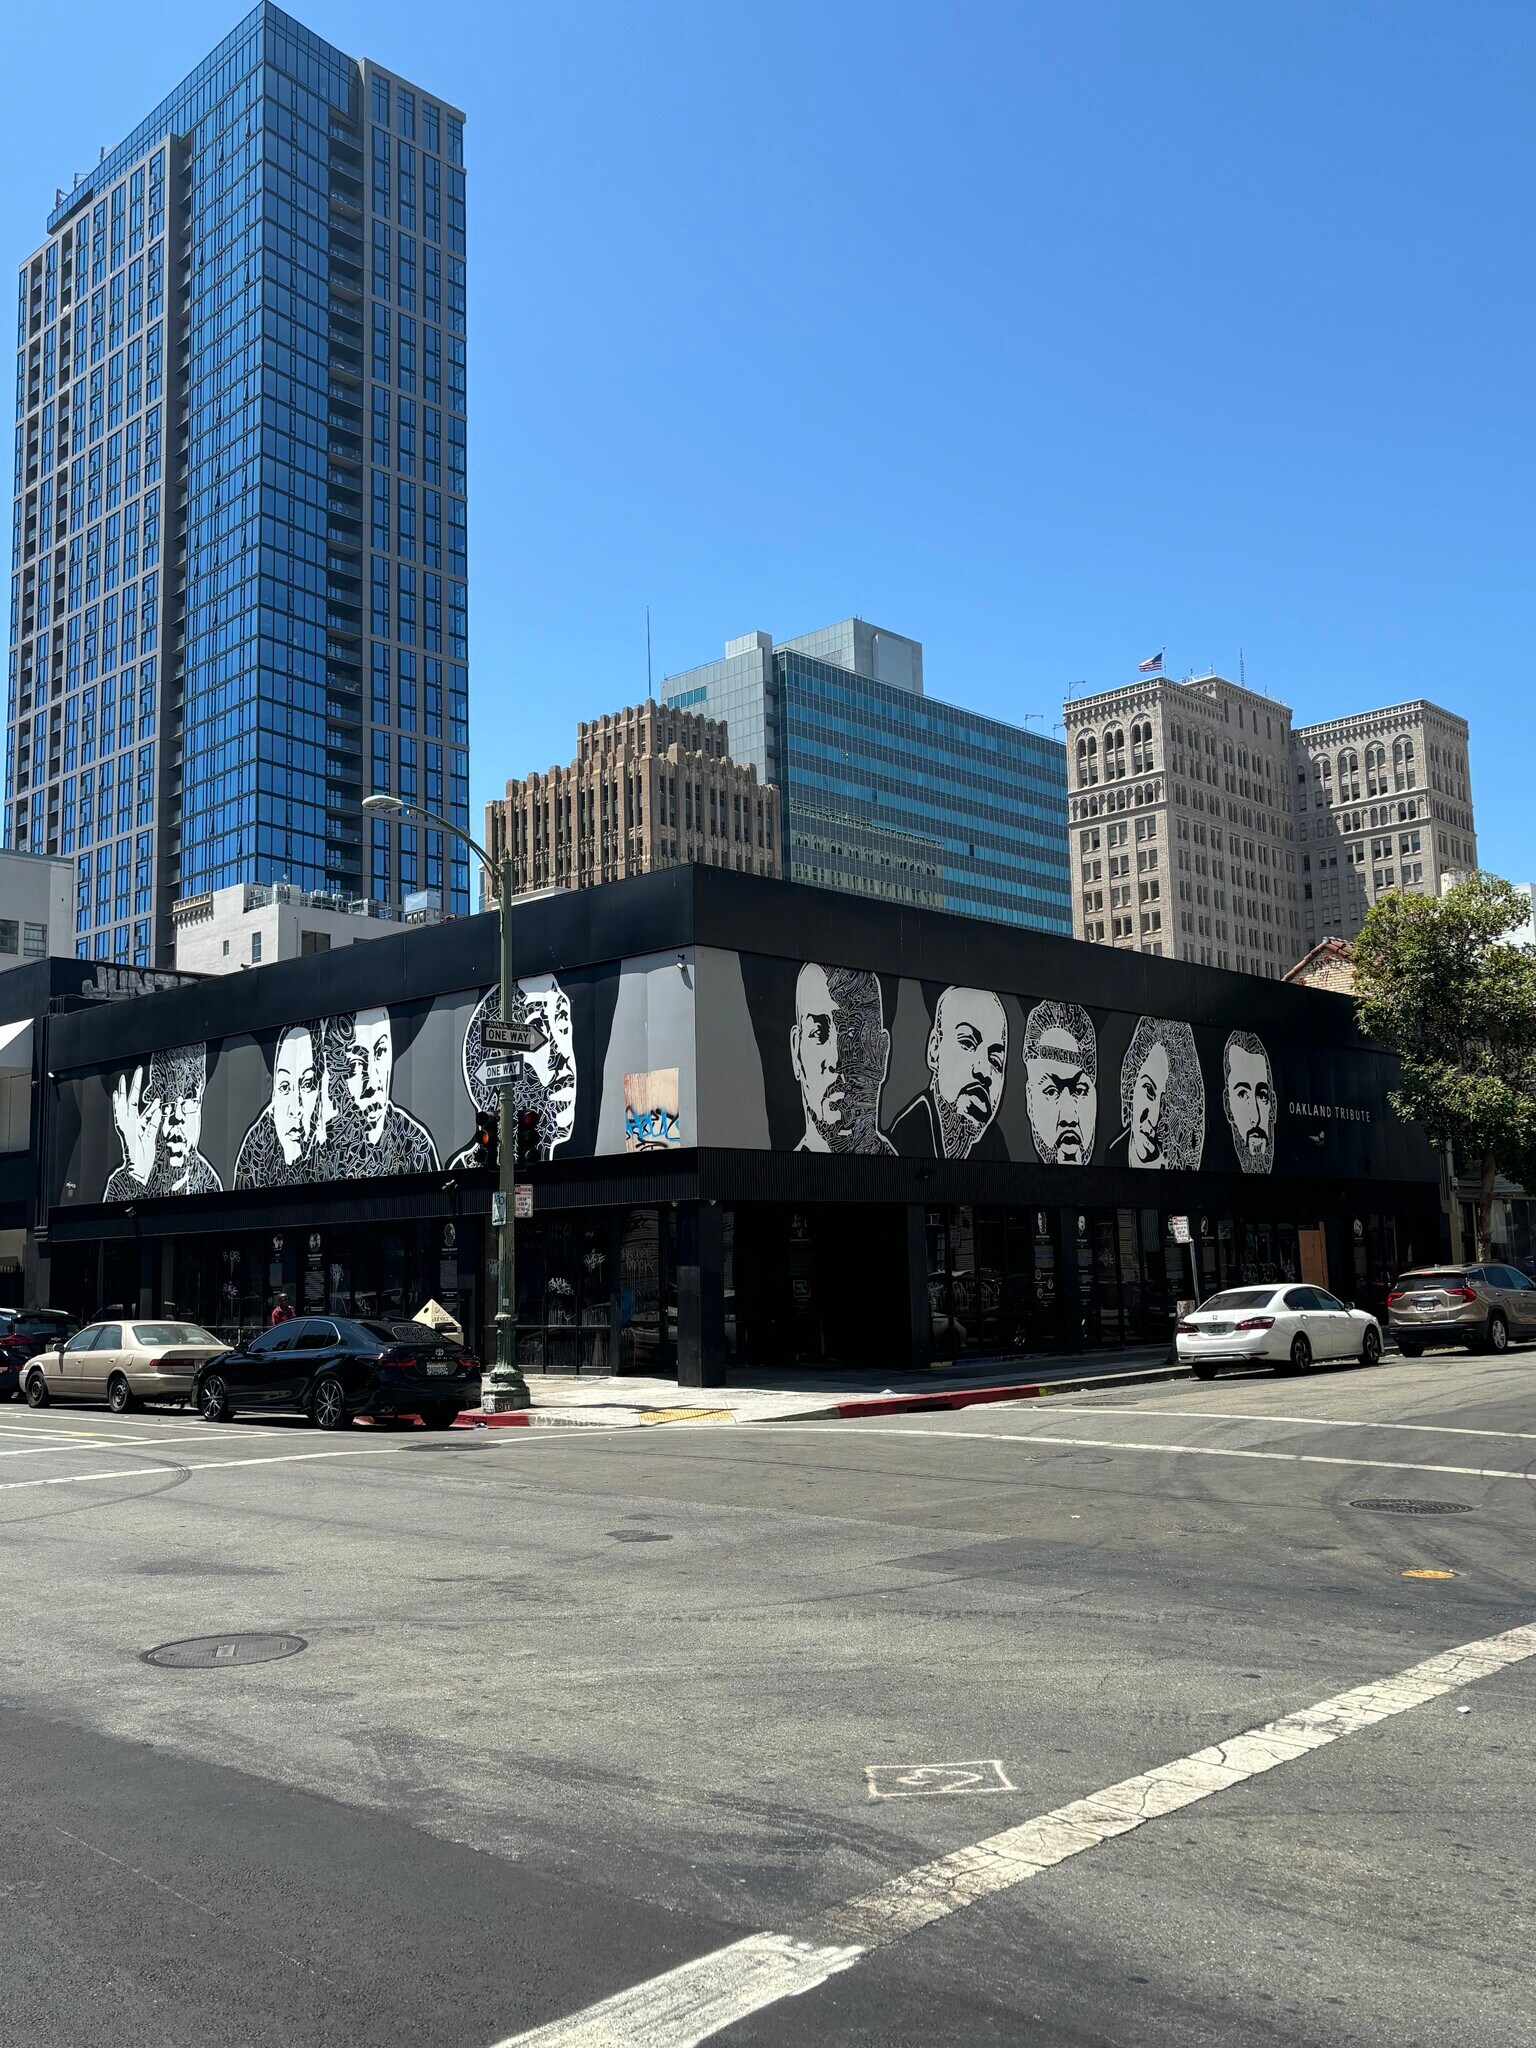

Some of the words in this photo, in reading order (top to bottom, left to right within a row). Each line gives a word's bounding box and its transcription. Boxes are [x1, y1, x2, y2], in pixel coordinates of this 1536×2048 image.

[488, 1029, 507, 1041] ONE
[510, 1031, 529, 1045] WAY
[486, 1066, 501, 1078] ONE
[503, 1062, 518, 1075] WAY
[1289, 1101, 1332, 1118] OAKLAND
[1334, 1106, 1371, 1123] TRIBUTE
